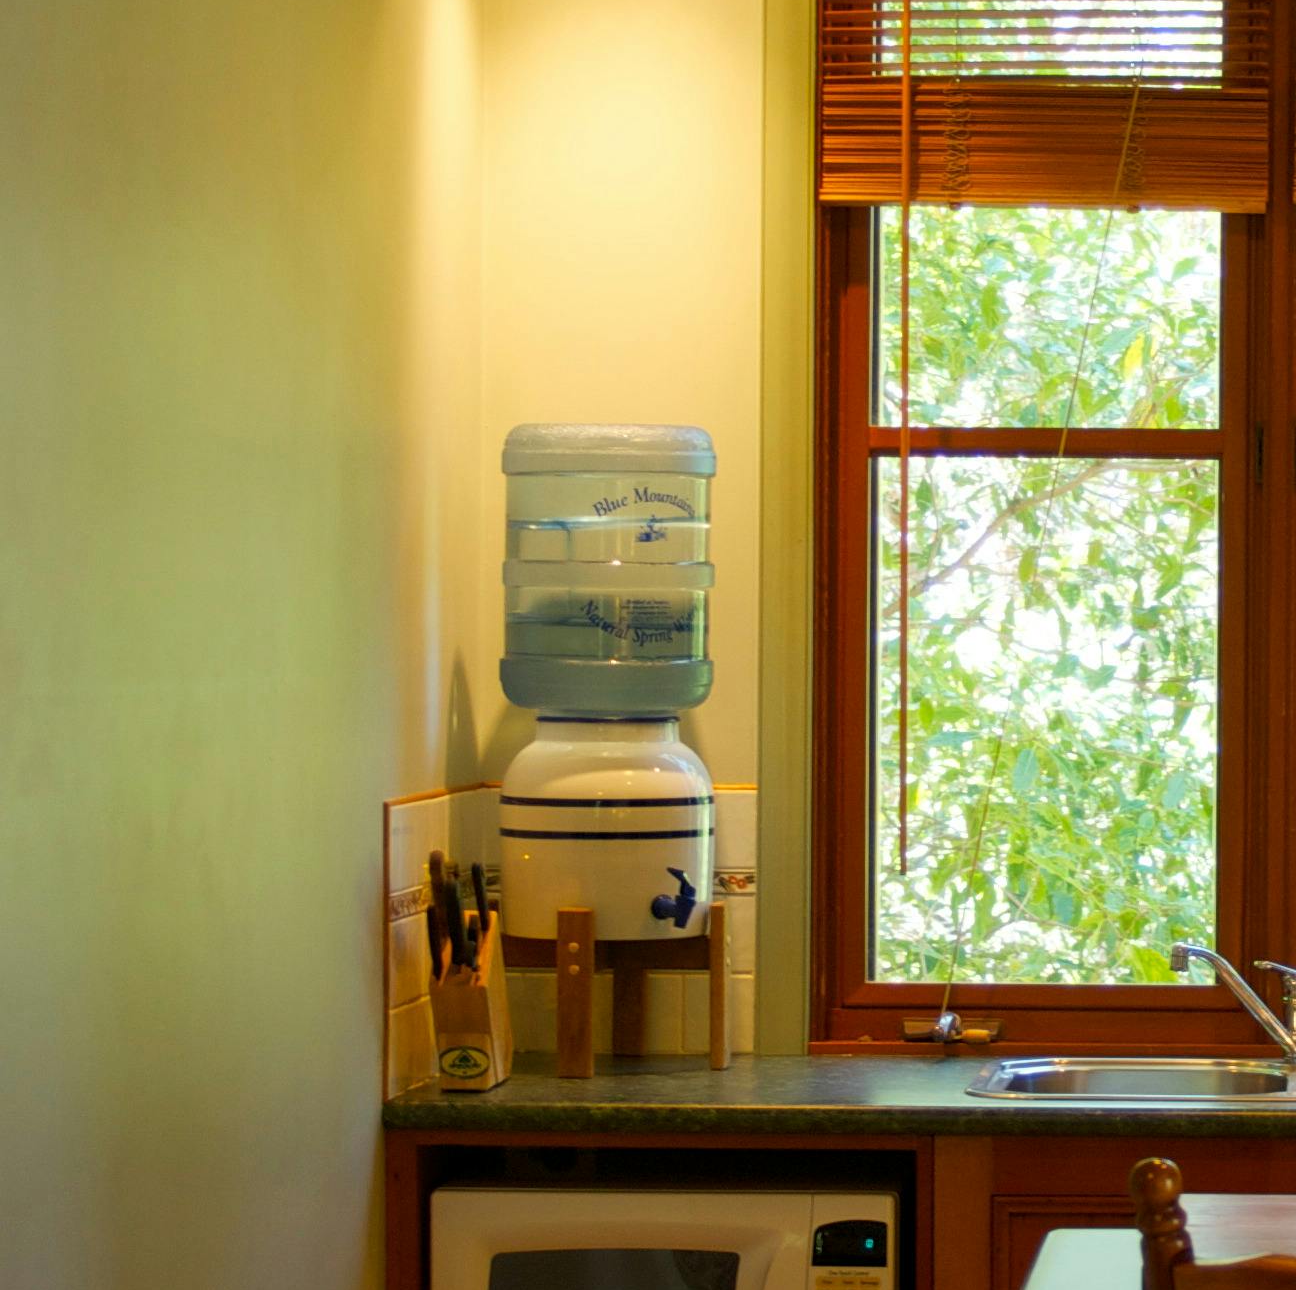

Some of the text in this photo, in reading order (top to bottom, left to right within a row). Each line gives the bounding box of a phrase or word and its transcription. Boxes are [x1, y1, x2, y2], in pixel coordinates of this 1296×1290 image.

[592, 497, 628, 517] Blue
[580, 599, 631, 640] Natural
[632, 627, 673, 647] Spring
